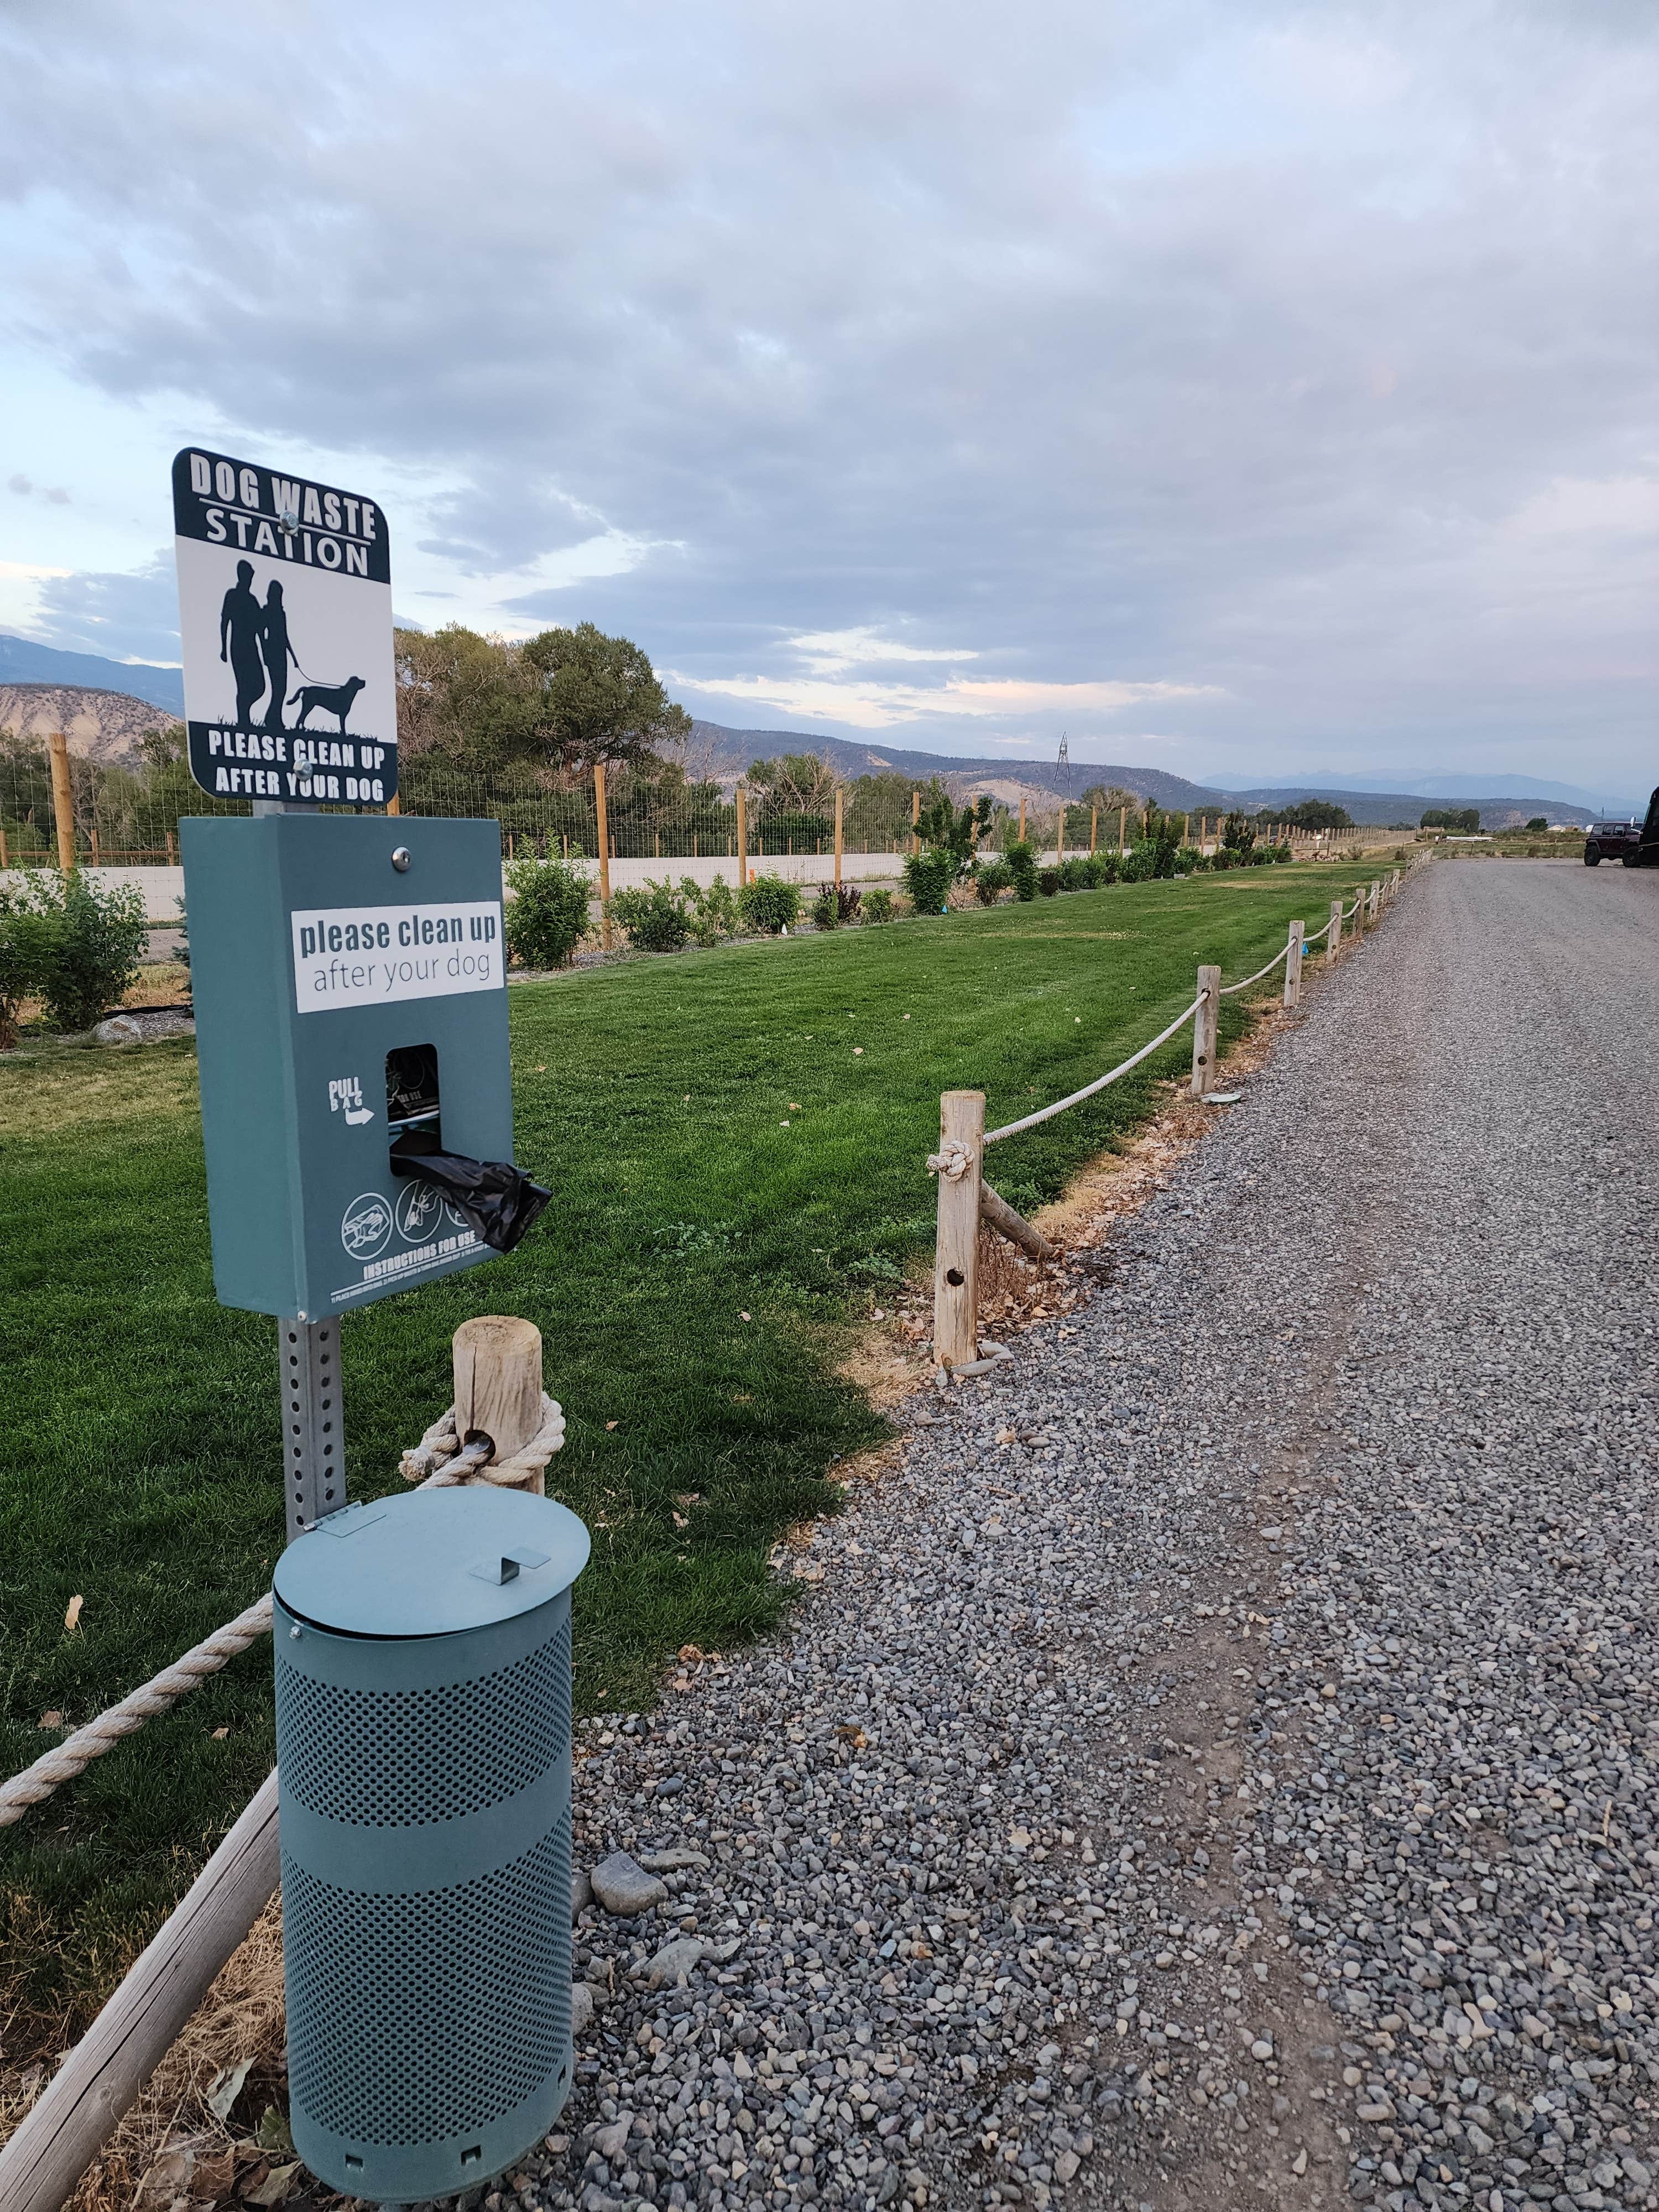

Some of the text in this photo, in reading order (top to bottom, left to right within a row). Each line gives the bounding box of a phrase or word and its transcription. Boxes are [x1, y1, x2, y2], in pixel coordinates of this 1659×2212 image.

[190, 453, 376, 540] DOG WASTE
[206, 509, 368, 576] STATION
[208, 730, 385, 770] PLEASE CLEAN UP
[216, 767, 384, 802] AFTER YOUR DOG
[300, 915, 495, 958] please clean up
[314, 949, 489, 992] after your dog
[328, 1076, 363, 1101] PULL
[331, 1096, 363, 1112] BAG
[363, 1243, 437, 1281] INSTRUCTIONS
[438, 1237, 457, 1254] FOR
[457, 1230, 476, 1247] USE
